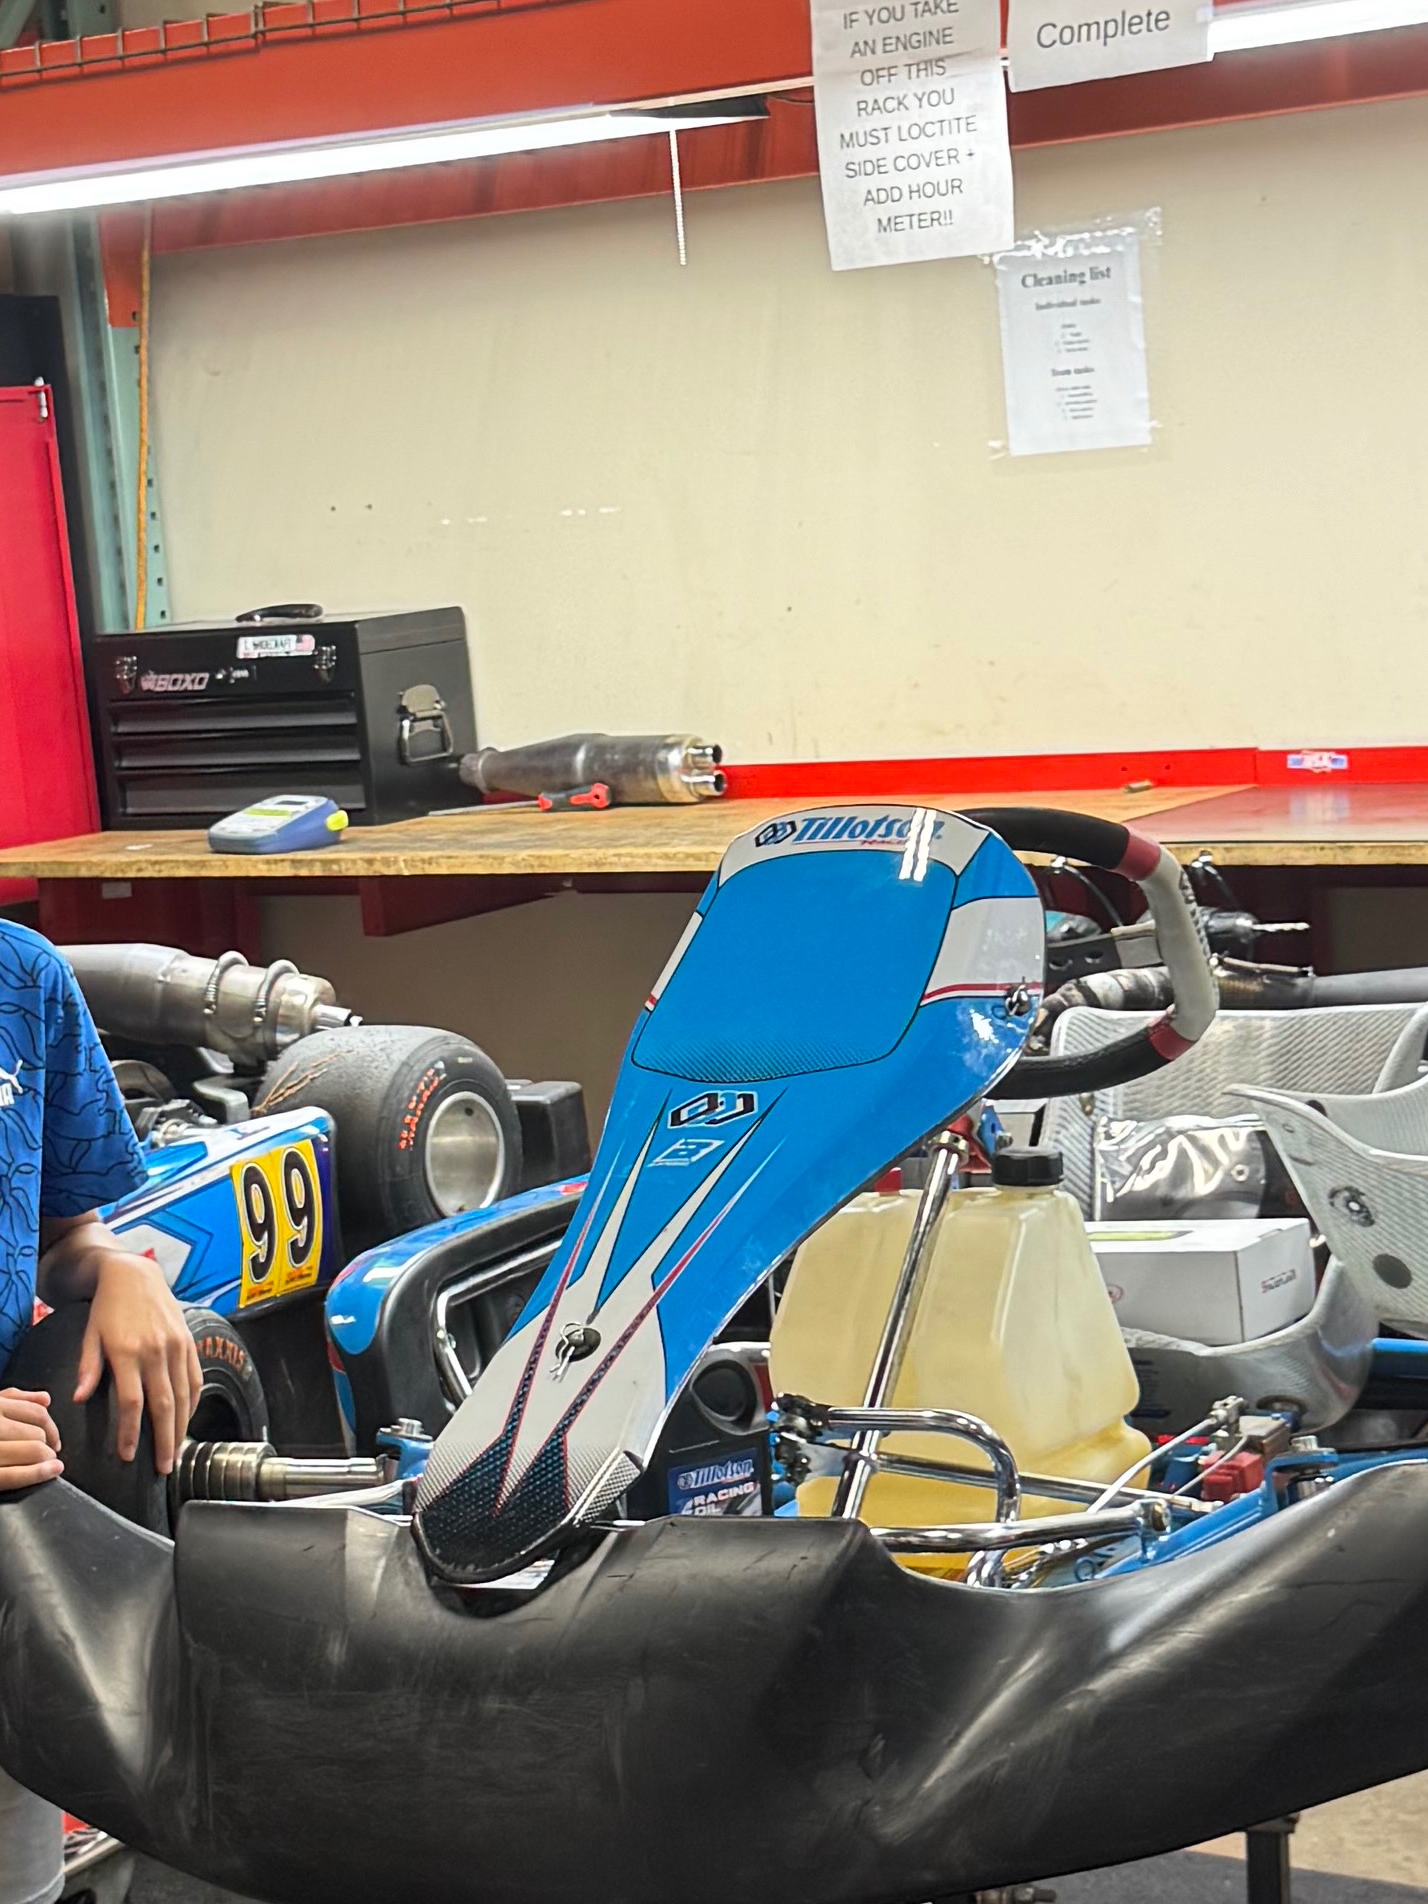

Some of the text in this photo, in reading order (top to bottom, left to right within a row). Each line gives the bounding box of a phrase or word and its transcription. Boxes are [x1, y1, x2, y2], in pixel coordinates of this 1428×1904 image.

[843, 11, 859, 30] IF
[866, 3, 905, 26] YOU
[1036, 9, 1171, 49] Complete
[849, 26, 954, 59] AN ENGINE
[859, 59, 947, 88] OFF THIS
[857, 88, 955, 118] RACK YOU
[839, 115, 978, 150] MUST LOCTITE
[845, 158, 888, 179] SIDE
[893, 147, 960, 172] COVER
[863, 177, 964, 207] ADD HOUR
[876, 209, 954, 234] METER!!
[1021, 266, 1112, 289] Cleaning list
[153, 673, 210, 692] BOXO
[241, 1146, 316, 1284] 99
[694, 1482, 755, 1506] RACING
[694, 1503, 722, 1516] OIL
